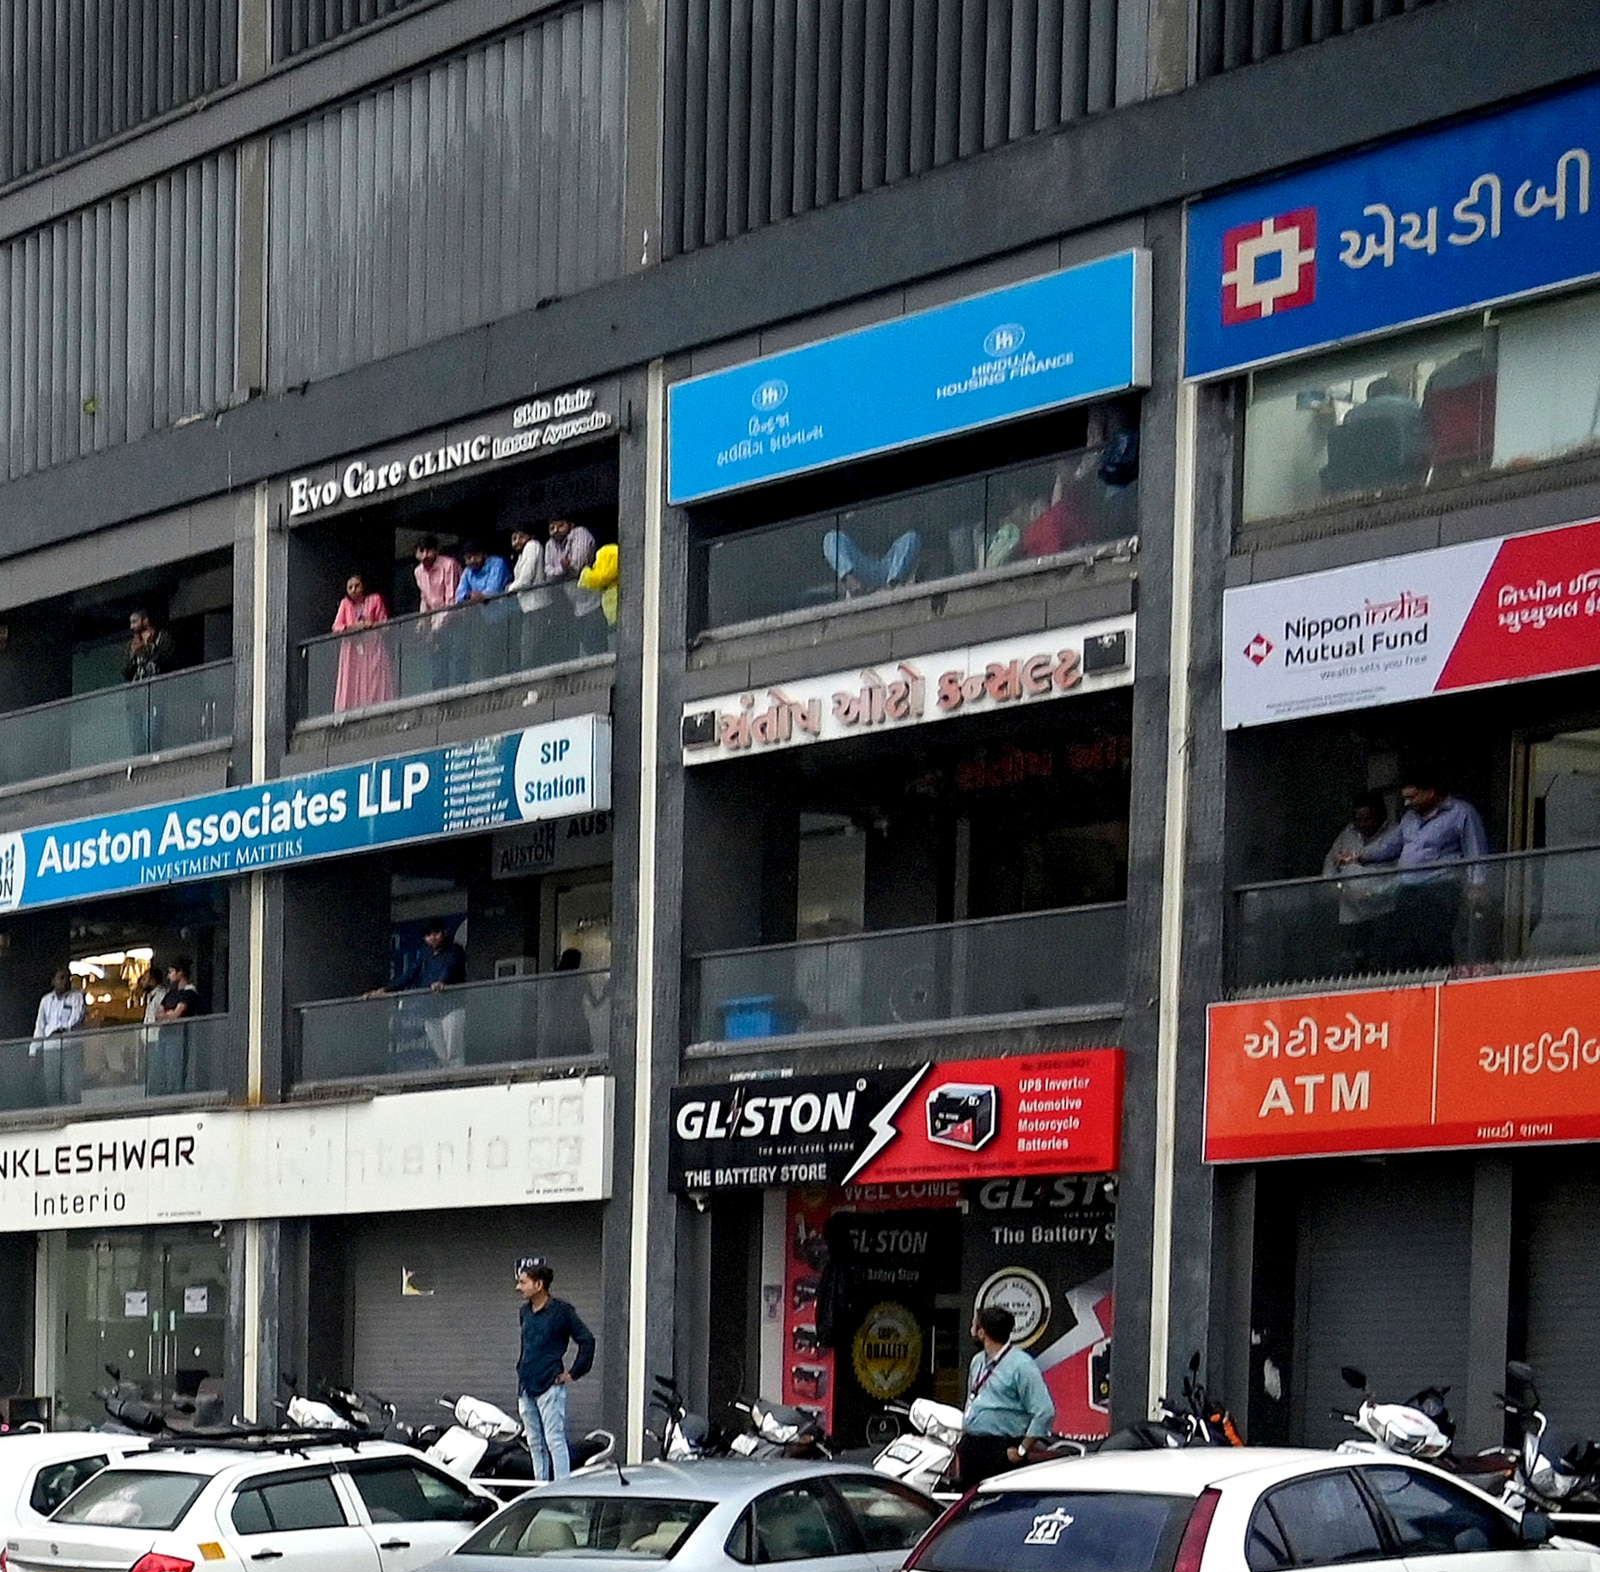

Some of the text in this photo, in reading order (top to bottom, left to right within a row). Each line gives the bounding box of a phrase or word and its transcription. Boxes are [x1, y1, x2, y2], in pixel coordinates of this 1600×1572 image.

[935, 352, 1074, 400] HOUSING FINANCE
[970, 350, 1036, 378] HINDUJA
[289, 434, 492, 517] Evo Care CLINIC
[1285, 612, 1362, 643] Nippon
[1285, 622, 1428, 667] Mutual Fund
[541, 739, 570, 765] SIP
[525, 775, 586, 804] Station
[37, 761, 430, 878] Auston Associates LLP
[1019, 1076, 1090, 1093] UPS Inverter
[1259, 1071, 1370, 1118] ATM
[1019, 1099, 1082, 1113] Automotive
[1018, 1118, 1080, 1133] Motorcycle
[1017, 1137, 1069, 1152] Batteries
[685, 1162, 827, 1187] THE BATTERY STORE
[34, 1191, 126, 1218] Interio
[993, 1226, 1024, 1244] The
[1031, 1225, 1099, 1246] Battery
[866, 1343, 909, 1359] QUALITY
